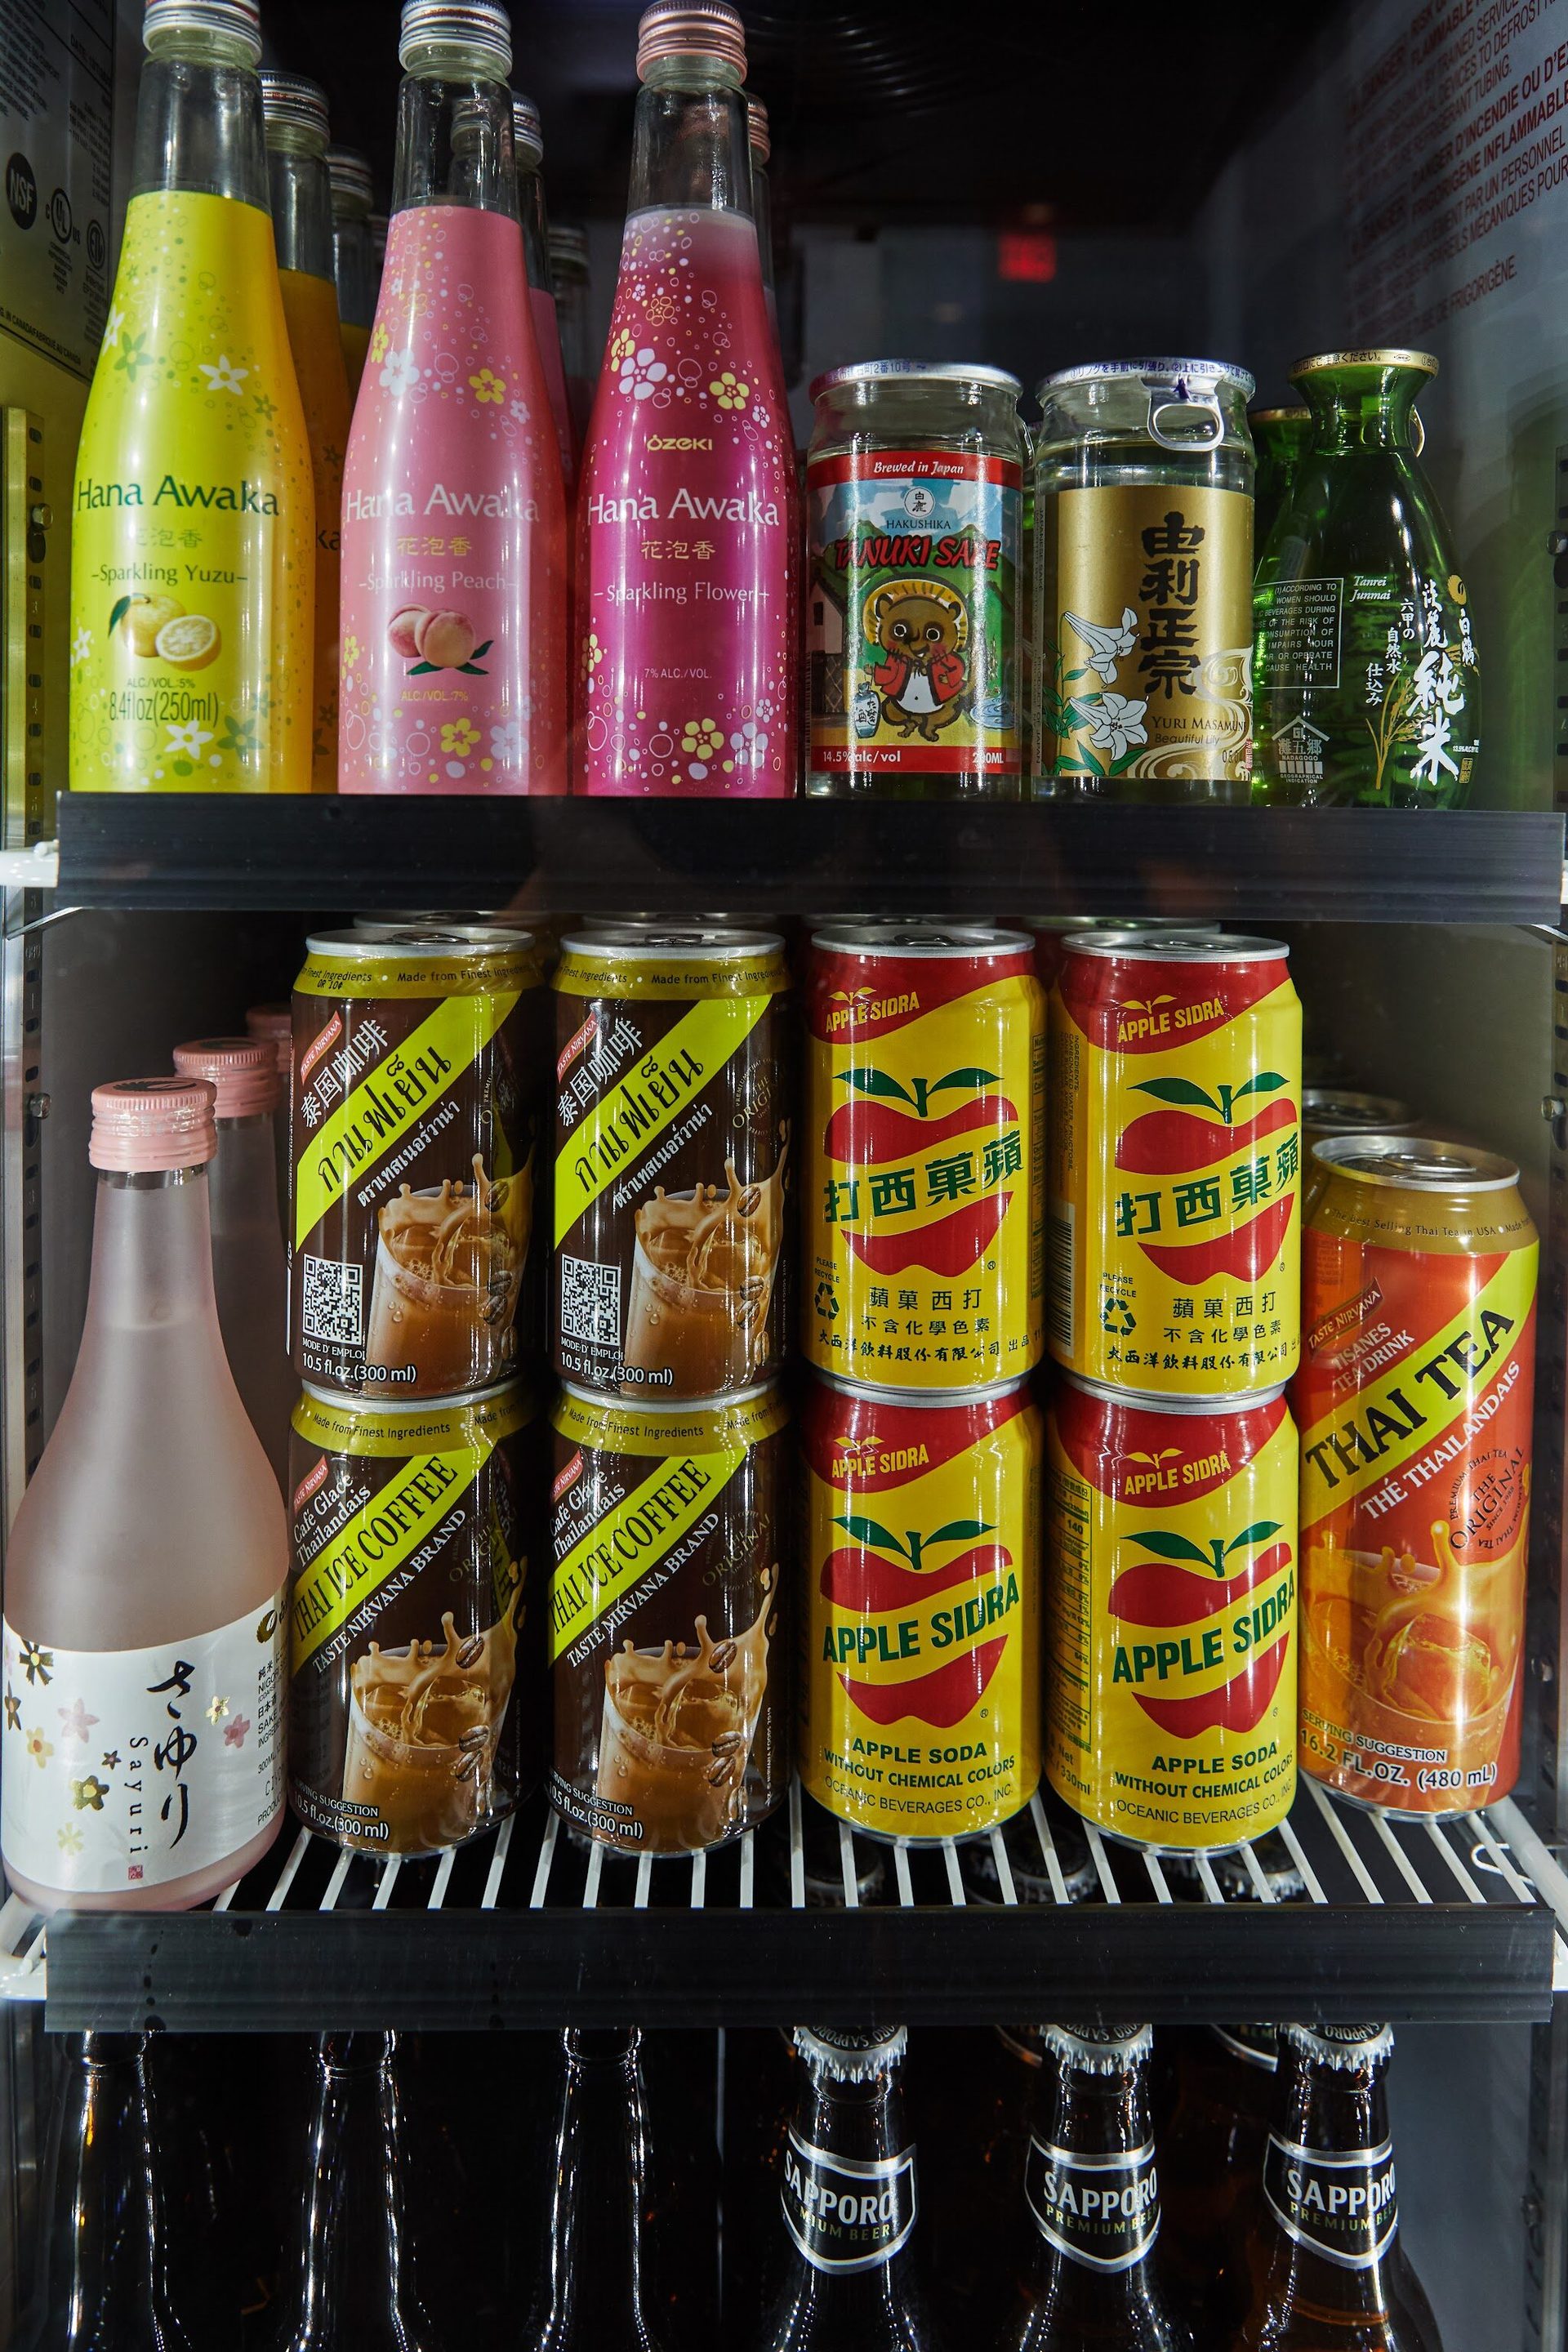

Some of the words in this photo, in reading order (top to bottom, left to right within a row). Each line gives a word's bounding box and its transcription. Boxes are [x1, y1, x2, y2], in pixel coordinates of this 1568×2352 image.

[1479, 41, 1492, 69] TO
[1474, 54, 1512, 103] TUBING.
[1455, 84, 1518, 156] D'INCENDIE
[1522, 65, 1540, 100] OU
[1486, 173, 1499, 203] UN
[1501, 125, 1566, 191] PERSONNEL
[10, 169, 33, 216] NSF
[1470, 177, 1535, 243] MÉCANIQUES
[1537, 154, 1568, 198] POUR
[1449, 253, 1517, 314] FRIGORIGÈNE.
[874, 461, 915, 474] Brewed
[918, 461, 929, 472] in
[931, 461, 964, 475] Japan
[77, 478, 144, 513] Hana
[153, 474, 279, 517] Awaka
[346, 489, 415, 523] Hana
[423, 483, 540, 523] Awaka
[588, 492, 660, 528] Hana
[667, 488, 780, 527] Awaka
[886, 519, 951, 530] HAKUSHIKA
[640, 540, 716, 560] 花泡香
[835, 535, 932, 571] TANUKI
[1276, 596, 1301, 604] WOMEN
[1304, 595, 1337, 603] SHOULD
[1350, 590, 1391, 603] Junmai
[1353, 575, 1388, 587] Tanrei
[1321, 628, 1334, 636] OF
[1323, 617, 1334, 625] OF
[1400, 599, 1415, 640] 六甲の
[1268, 641, 1302, 649] IMPAIRS
[1365, 662, 1384, 706] 仕込み
[1152, 717, 1187, 729] YURI
[1192, 717, 1247, 732] MASAMUN
[1406, 650, 1465, 786] 純米
[855, 751, 901, 764] alc/vol
[1155, 733, 1204, 745] Beautiful
[398, 972, 426, 982] Made
[431, 971, 457, 982] from
[461, 969, 491, 980] Finest
[652, 975, 679, 985] Made
[684, 975, 709, 985] from
[826, 1003, 869, 1034] APPLE
[871, 991, 920, 1021] SIDRA
[1118, 1013, 1170, 1044] APPLE
[1174, 998, 1225, 1027] SIDRA
[314, 1020, 341, 1054] NIRVANA
[301, 1019, 388, 1129] 泰国咖啡
[558, 1018, 643, 1127] 泰国咖啡
[318, 1046, 452, 1192] กาแฟเย็น
[575, 1049, 704, 1193] กาแฟเย็น
[1374, 1220, 1412, 1236] Selling
[1415, 1225, 1438, 1236] Thai
[1443, 1227, 1459, 1236] Tea
[1477, 1227, 1495, 1236] USA
[870, 1287, 982, 1310] 蘋菓西打
[1173, 1291, 1276, 1319] 蘋菓西打
[1308, 1323, 1334, 1349] TASTE
[1336, 1290, 1380, 1330] NIRVANA
[302, 1336, 322, 1353] MODE
[1333, 1322, 1392, 1370] TISANES
[1362, 1329, 1415, 1373] DRINK
[302, 1352, 322, 1372] 10.5
[390, 1365, 416, 1383] ml)
[560, 1352, 581, 1372] 10.5
[648, 1368, 674, 1386] ml)
[1305, 1388, 1428, 1489] THAI
[1414, 1309, 1515, 1401] TEA
[313, 1413, 331, 1429] Made
[332, 1421, 352, 1435] from
[353, 1424, 385, 1438] Finest
[387, 1423, 451, 1441] Ingredients
[608, 1422, 639, 1437] Finest
[644, 1425, 704, 1441] Ingredients
[1361, 1477, 1409, 1519] THÉ
[1402, 1361, 1521, 1488] THAILANDAIS
[832, 1456, 875, 1479] APPLE
[880, 1444, 929, 1474] SIDRA
[1125, 1472, 1178, 1495] APPLE
[1183, 1450, 1232, 1485] SIDRA
[314, 1473, 354, 1517] Glace
[568, 1471, 608, 1509] Glace
[1450, 1448, 1525, 1549] ORIGINAL
[1473, 1472, 1496, 1502] THE
[323, 1545, 368, 1600] ICE
[356, 1456, 458, 1561] COFFEE
[577, 1543, 622, 1589] ICE
[612, 1459, 711, 1560] COFFEE
[312, 1630, 351, 1673] TASTE
[346, 1570, 415, 1638] NIRVANA
[410, 1509, 466, 1573] BRAND
[567, 1628, 605, 1668] TASTE
[600, 1573, 669, 1636] NIRVANA
[664, 1512, 719, 1574] BRAND
[822, 1619, 921, 1664] APPLE
[930, 1572, 1020, 1649] SIDRA
[1112, 1628, 1224, 1683] APPLE
[1232, 1568, 1295, 1654] SIDRA
[258, 1708, 278, 1735] SAKE
[1302, 1708, 1353, 1744] SERVING
[1355, 1735, 1446, 1762] SUGGESTION
[146, 1659, 198, 1850] さゆり
[824, 1748, 884, 1783] WITHOUT
[888, 1771, 963, 1788] CHEMICAL
[968, 1755, 1015, 1784] COLORS
[853, 1738, 920, 1764] APPLE
[929, 1742, 987, 1764] SODA
[1152, 1756, 1224, 1774] APPLE
[1232, 1741, 1277, 1771] SODA
[1300, 1728, 1336, 1762] 16.2
[1342, 1749, 1410, 1786] FL.OZ.
[1417, 1769, 1461, 1790] (480
[1467, 1762, 1498, 1786] mL)
[1060, 1764, 1090, 1796] 330ml
[1115, 1771, 1187, 1798] WITHOUT
[1192, 1778, 1260, 1798] CHEMICAL
[1263, 1750, 1293, 1784] COLORS
[124, 1736, 149, 1854] Sayuri
[319, 1793, 379, 1817] SUGGESTION
[572, 1787, 632, 1816] SUGGESTION
[825, 1775, 876, 1806] OCEANIC
[880, 1797, 962, 1814] BEVERAGES
[1116, 1799, 1179, 1824] OCEANIC
[1183, 1805, 1260, 1824] BEVERAGES
[364, 1822, 390, 1841] ml)
[619, 1821, 644, 1840] ml)
[783, 2150, 893, 2225] SAPPORO
[1044, 2167, 1158, 2220] SAPPORO
[1287, 2161, 1396, 2216] SAPPORO
[849, 2224, 891, 2242] BEER
[1046, 2204, 1126, 2235] PREMIUM
[1290, 2201, 1371, 2232] PREMIUM
